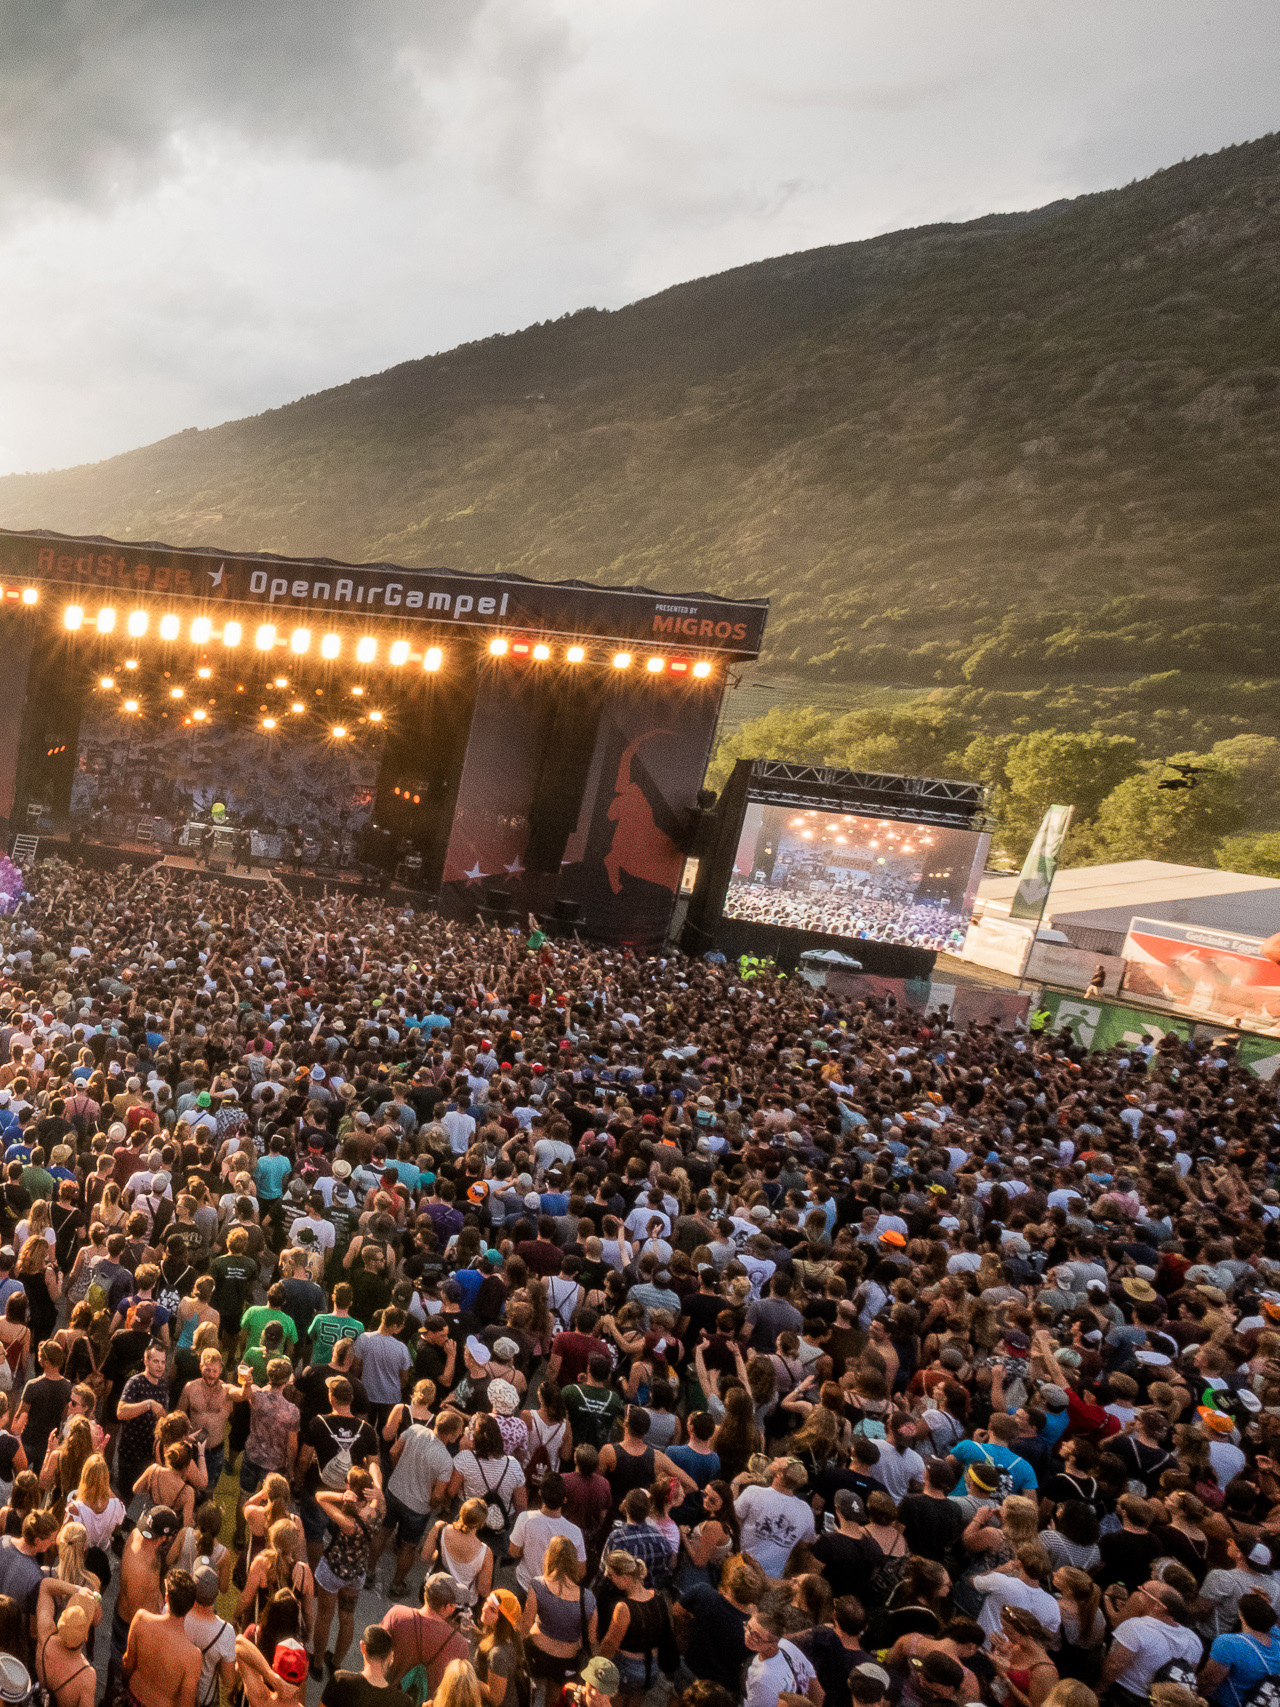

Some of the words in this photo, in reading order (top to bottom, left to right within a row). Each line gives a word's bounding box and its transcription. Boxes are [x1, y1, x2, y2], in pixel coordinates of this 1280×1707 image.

[37, 548, 192, 591] RedStage
[249, 571, 509, 619] OpenAirGampel
[655, 603, 688, 614] PRESENTED
[689, 606, 699, 615] BY
[652, 614, 748, 641] MIGROS
